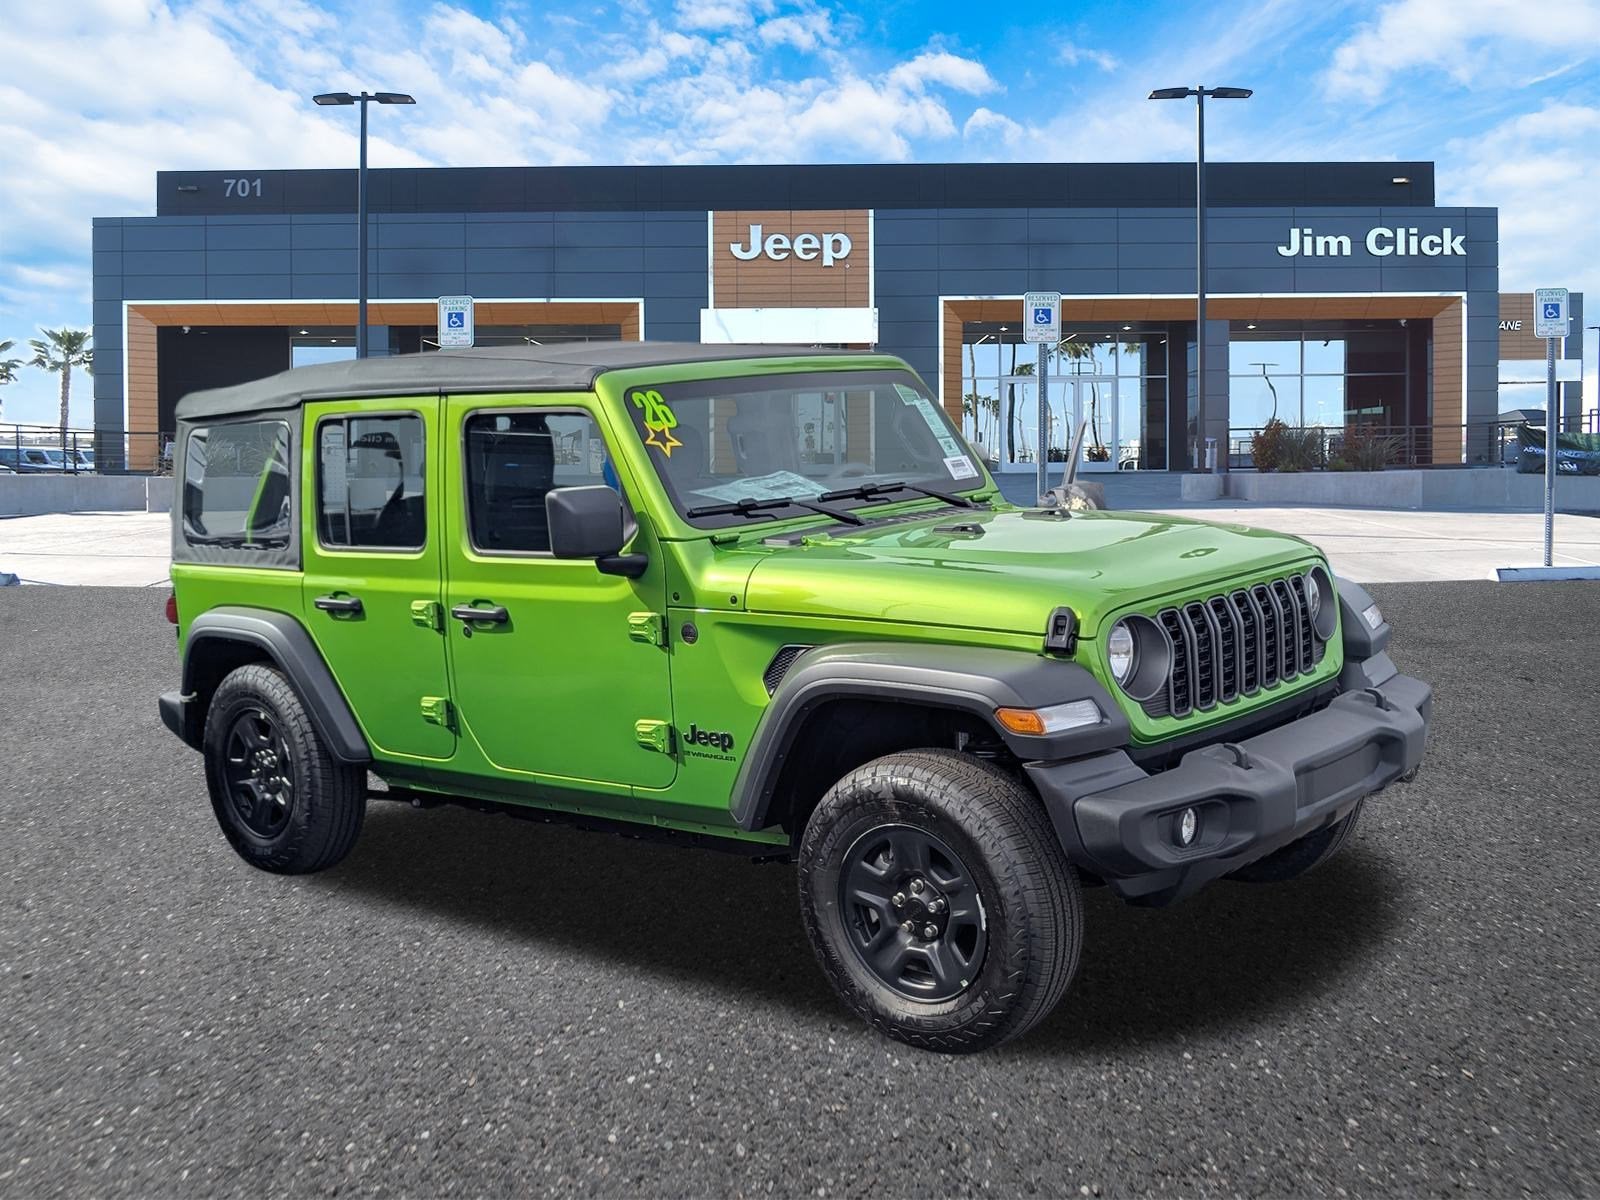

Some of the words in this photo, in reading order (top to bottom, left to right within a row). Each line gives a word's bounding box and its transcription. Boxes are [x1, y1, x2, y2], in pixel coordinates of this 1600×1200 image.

[223, 178, 262, 197] 701
[729, 223, 852, 267] Jeep
[1277, 227, 1351, 256] Jim
[1366, 227, 1467, 256] Click
[1498, 320, 1521, 331] ANE
[632, 389, 677, 430] 26
[683, 722, 735, 753] Jeep
[691, 751, 736, 762] WRANGLER
